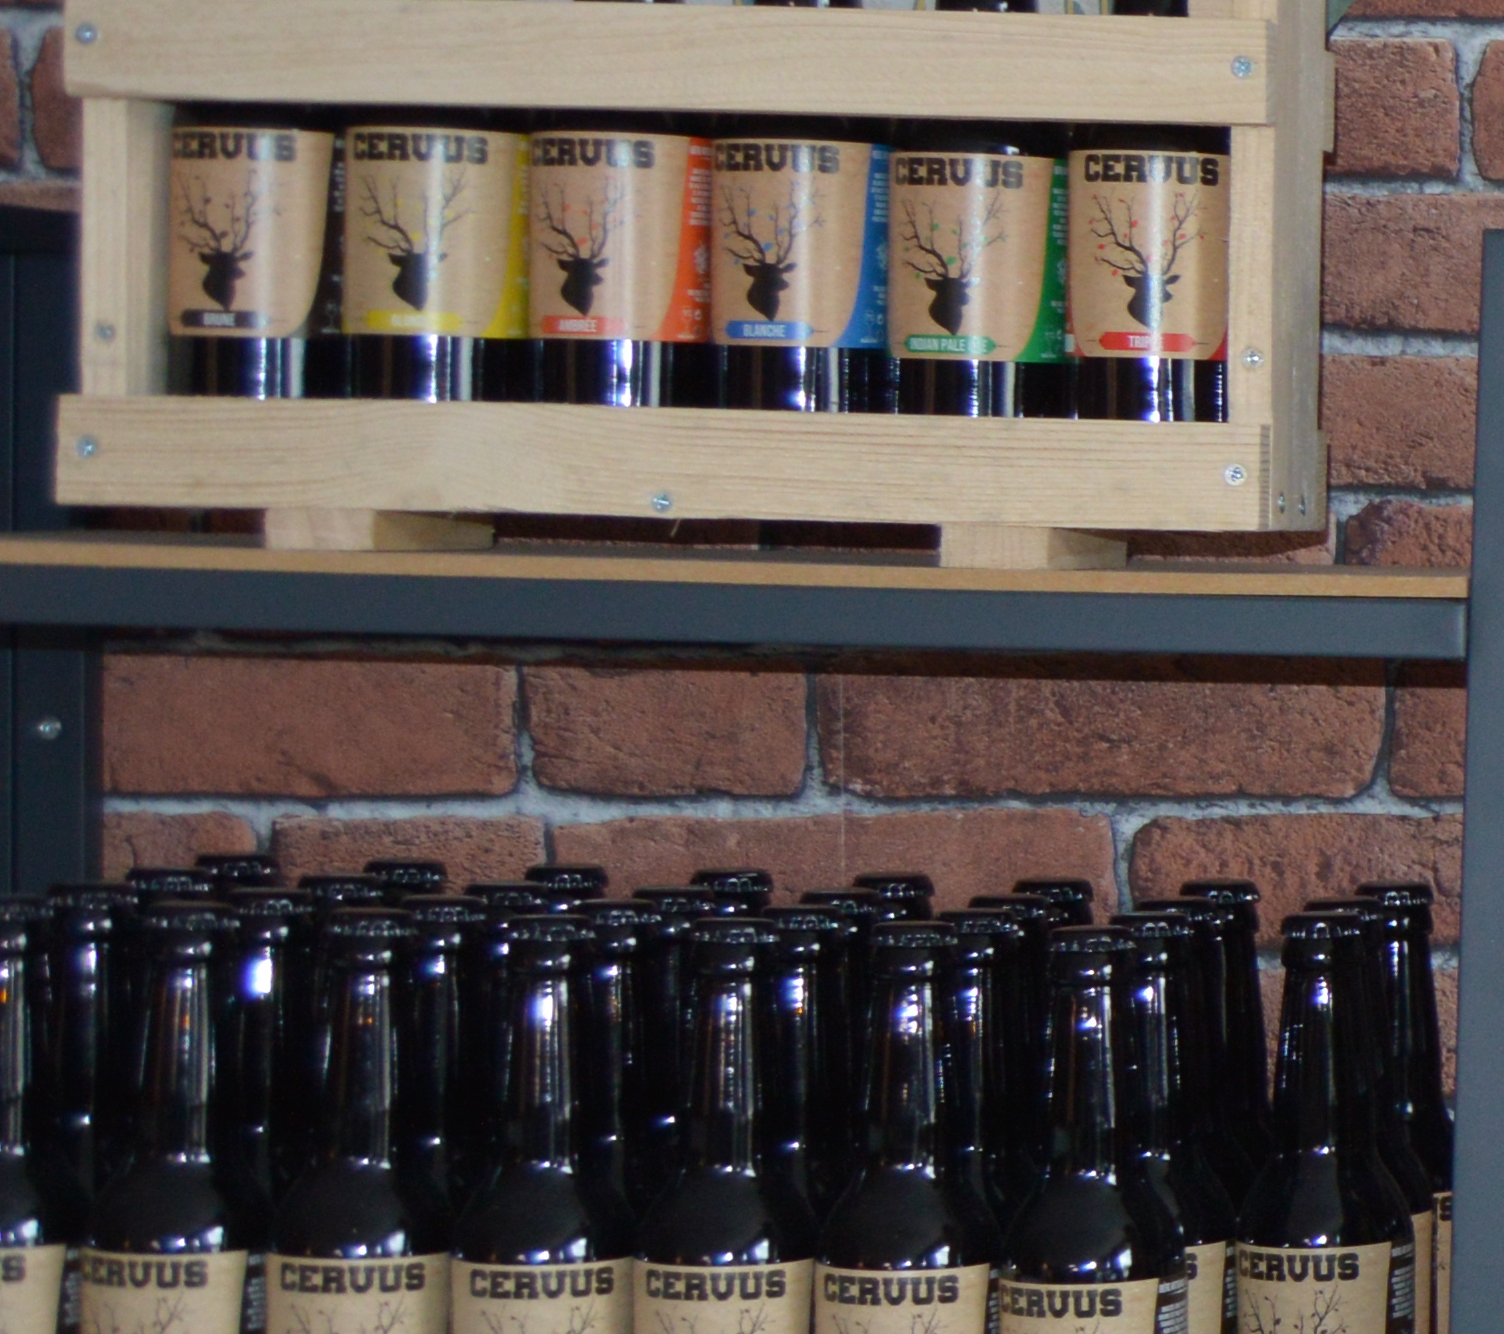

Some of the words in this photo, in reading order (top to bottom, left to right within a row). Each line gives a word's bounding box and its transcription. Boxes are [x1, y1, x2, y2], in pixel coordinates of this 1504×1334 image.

[1083, 153, 1220, 187] CERVUS
[279, 1262, 426, 1294] CERVUS
[1238, 1251, 1359, 1283] CERVUS
[469, 1268, 615, 1300] CERVUS
[645, 1269, 787, 1302] CERVUS
[823, 1273, 959, 1307] CERVUS
[1001, 1286, 1123, 1320] CERVUS
